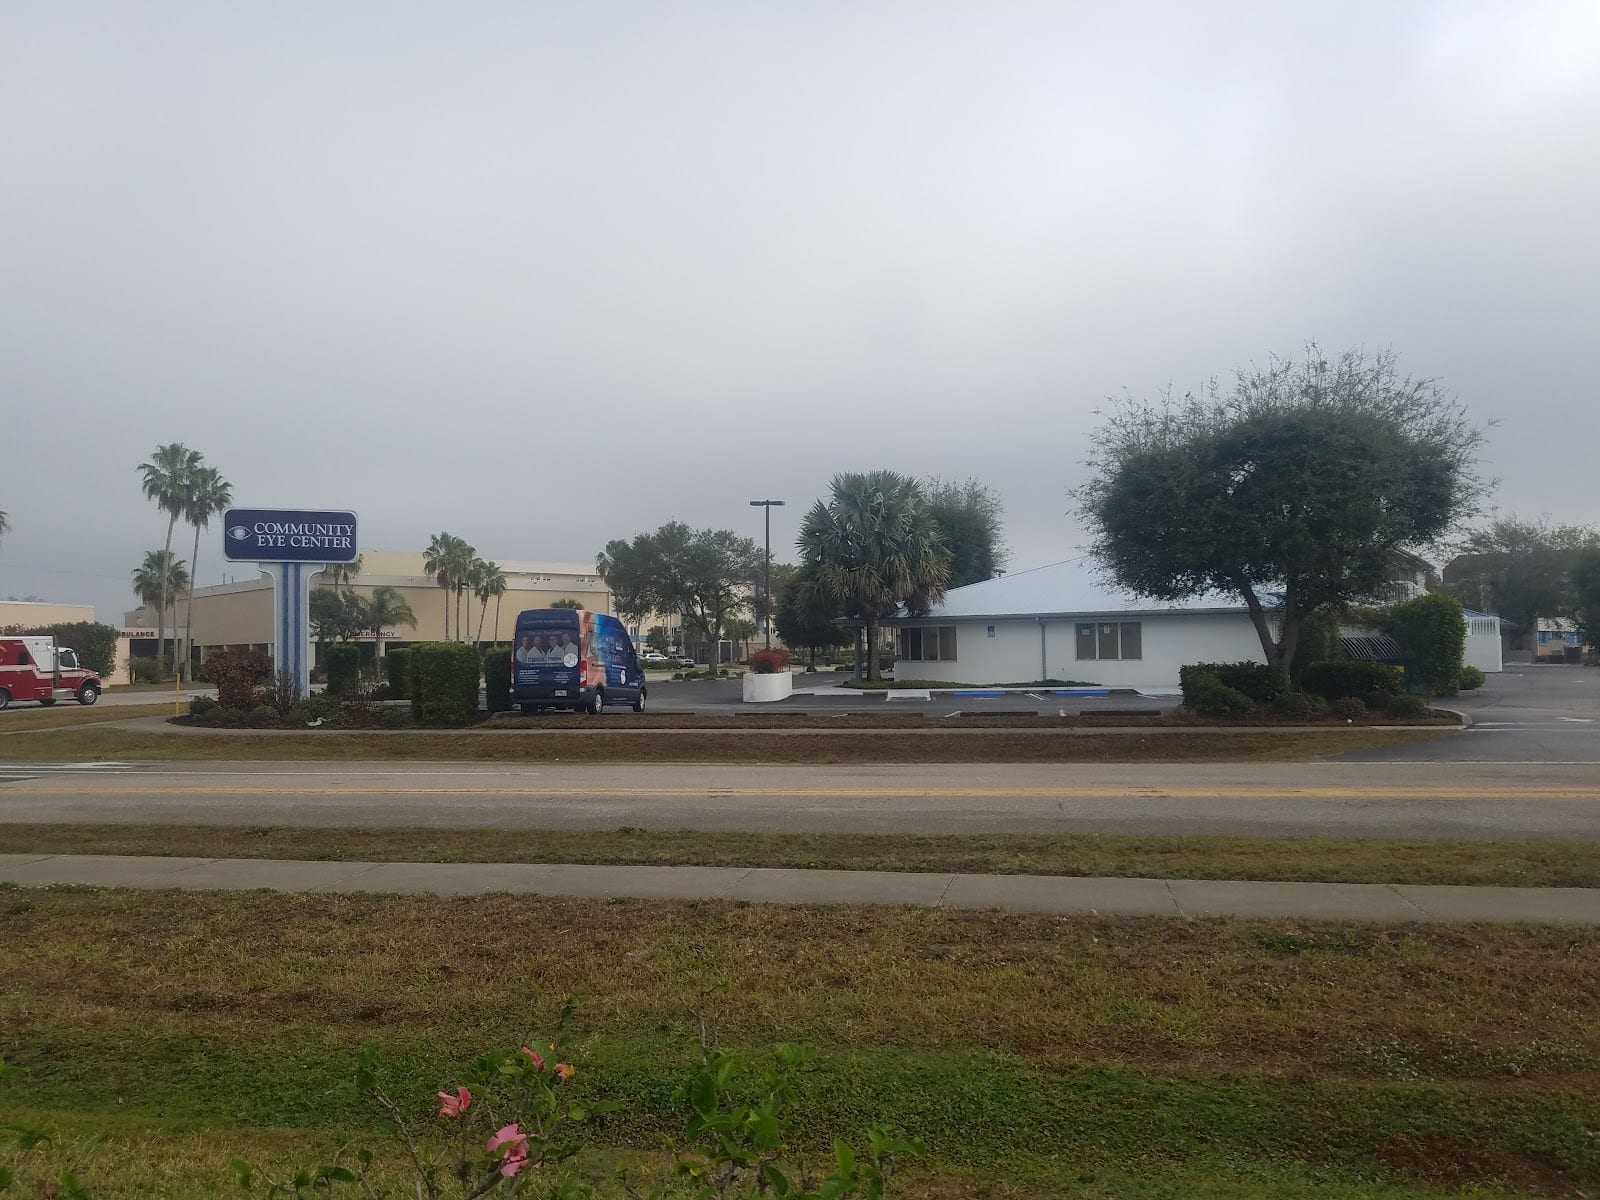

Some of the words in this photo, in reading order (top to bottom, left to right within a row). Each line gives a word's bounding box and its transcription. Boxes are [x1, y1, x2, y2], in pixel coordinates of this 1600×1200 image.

[254, 522, 353, 536] COMMUNITY
[257, 534, 286, 547] EYE
[290, 535, 352, 548] CENTER
